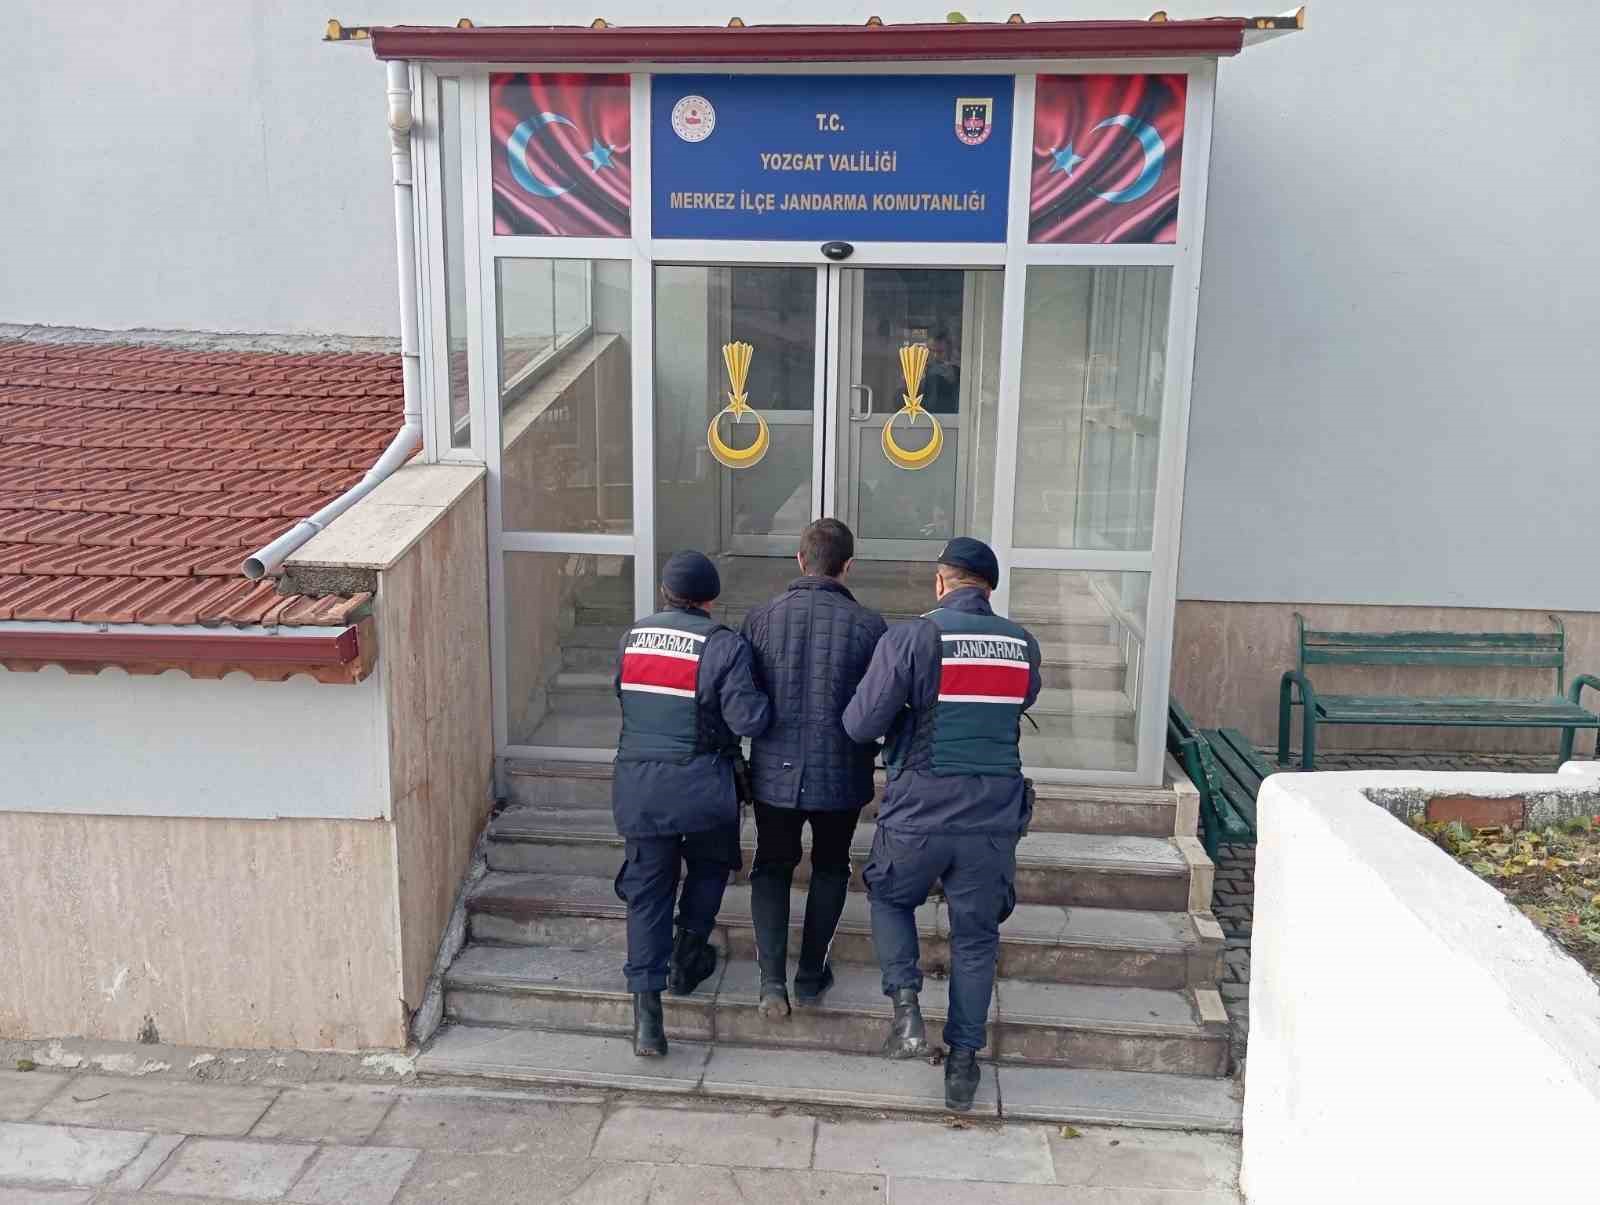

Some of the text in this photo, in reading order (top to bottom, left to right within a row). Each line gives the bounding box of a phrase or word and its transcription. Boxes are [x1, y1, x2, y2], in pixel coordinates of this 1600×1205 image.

[816, 113, 845, 132] T.C.
[760, 151, 897, 172] YOZGAT VALİLİĞİ
[670, 190, 985, 215] MERKEZ İLÇE JANDARMA KOMUTANLIĞI
[632, 632, 694, 654] JANDARMA
[953, 640, 1024, 660] JANDARMA
